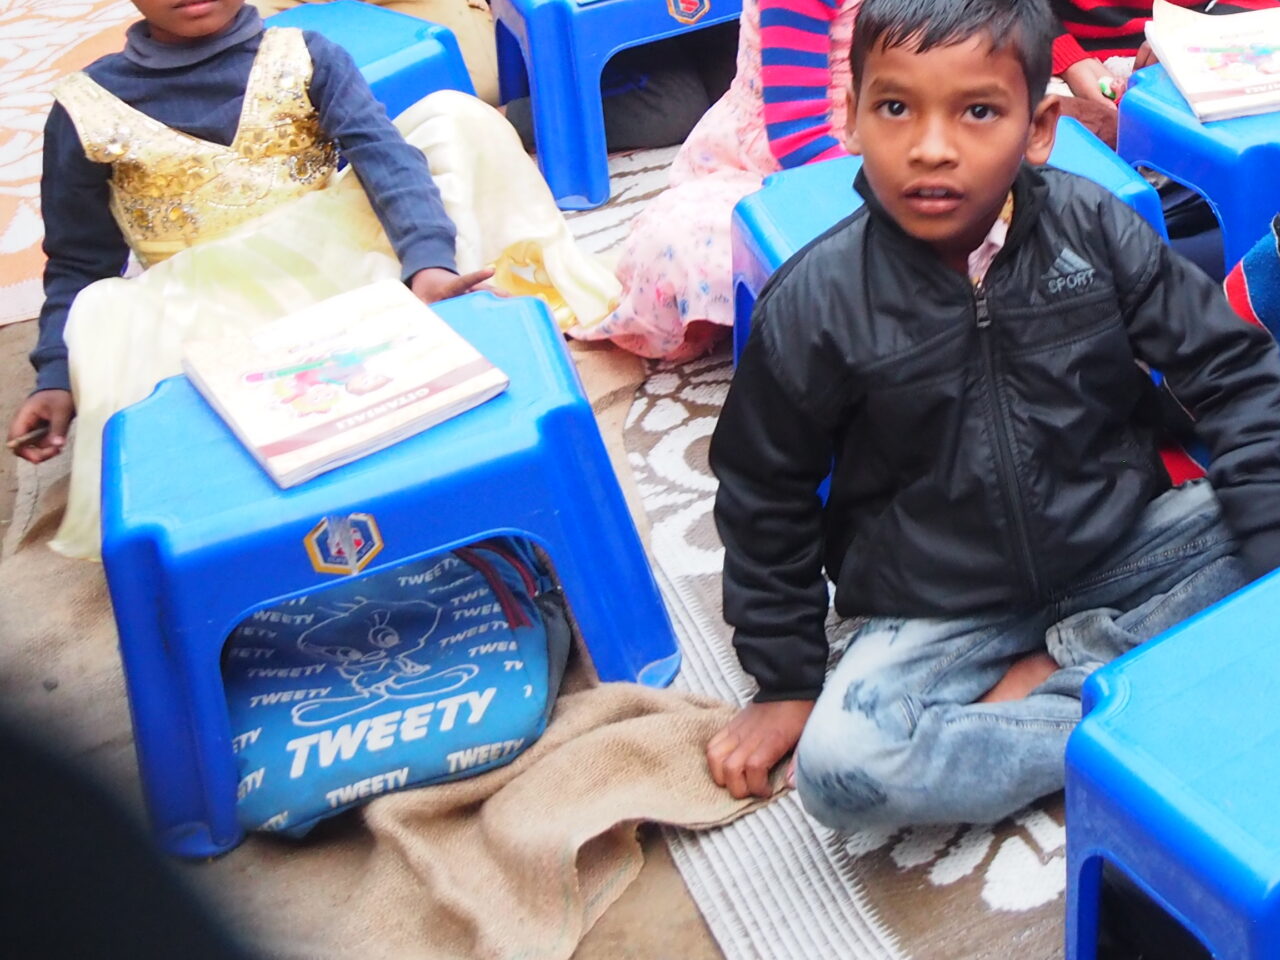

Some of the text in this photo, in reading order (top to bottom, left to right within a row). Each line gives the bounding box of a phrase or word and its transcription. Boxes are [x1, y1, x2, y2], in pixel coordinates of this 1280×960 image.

[1048, 268, 1095, 293] SPORT
[247, 663, 326, 678] TWEETY
[249, 686, 332, 708] TWEETY
[285, 688, 496, 780] TWEETY
[447, 738, 524, 773] TWEETY
[326, 767, 409, 808] TWEETY
